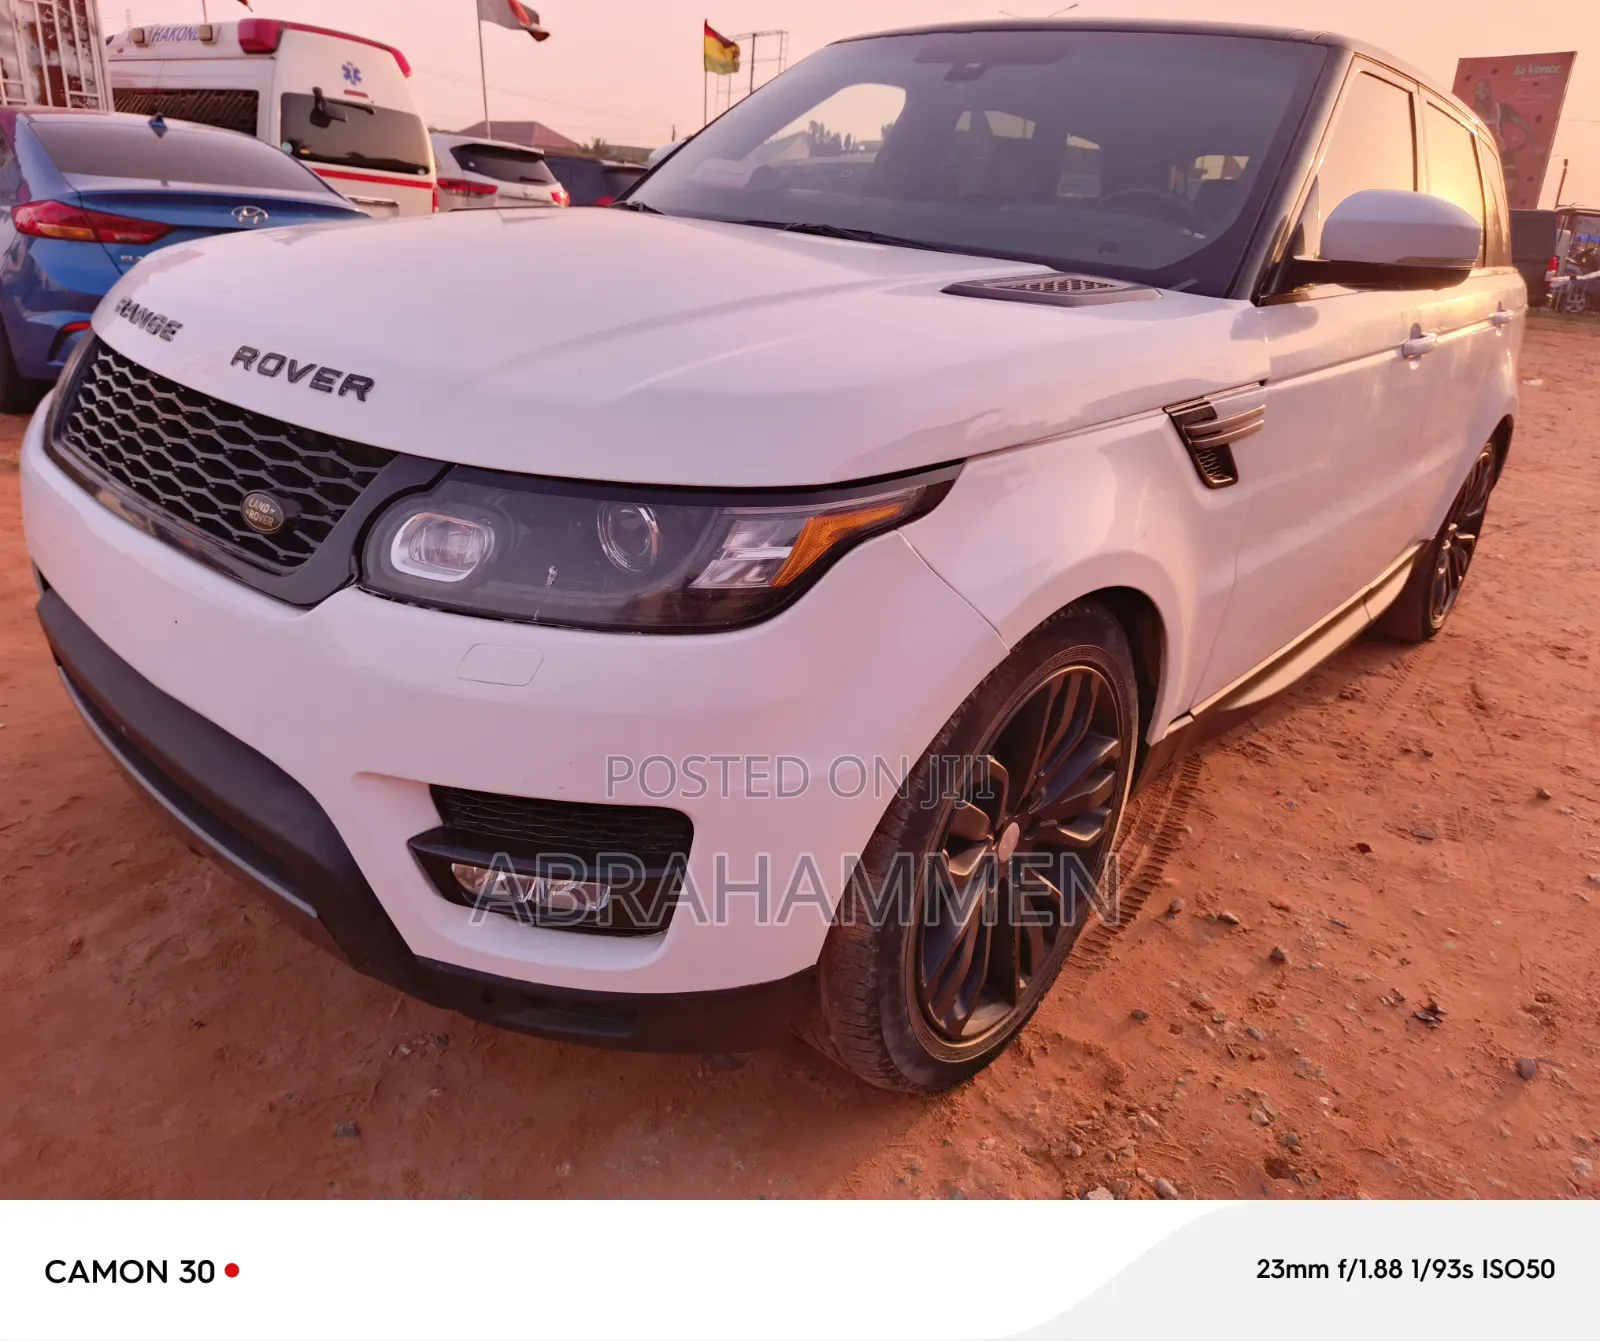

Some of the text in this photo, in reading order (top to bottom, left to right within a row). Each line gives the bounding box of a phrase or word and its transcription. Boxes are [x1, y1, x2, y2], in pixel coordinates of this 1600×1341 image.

[115, 296, 183, 342] RANGE
[230, 345, 375, 402] ROVER
[248, 498, 270, 513] LAND
[248, 510, 274, 527] ROVER
